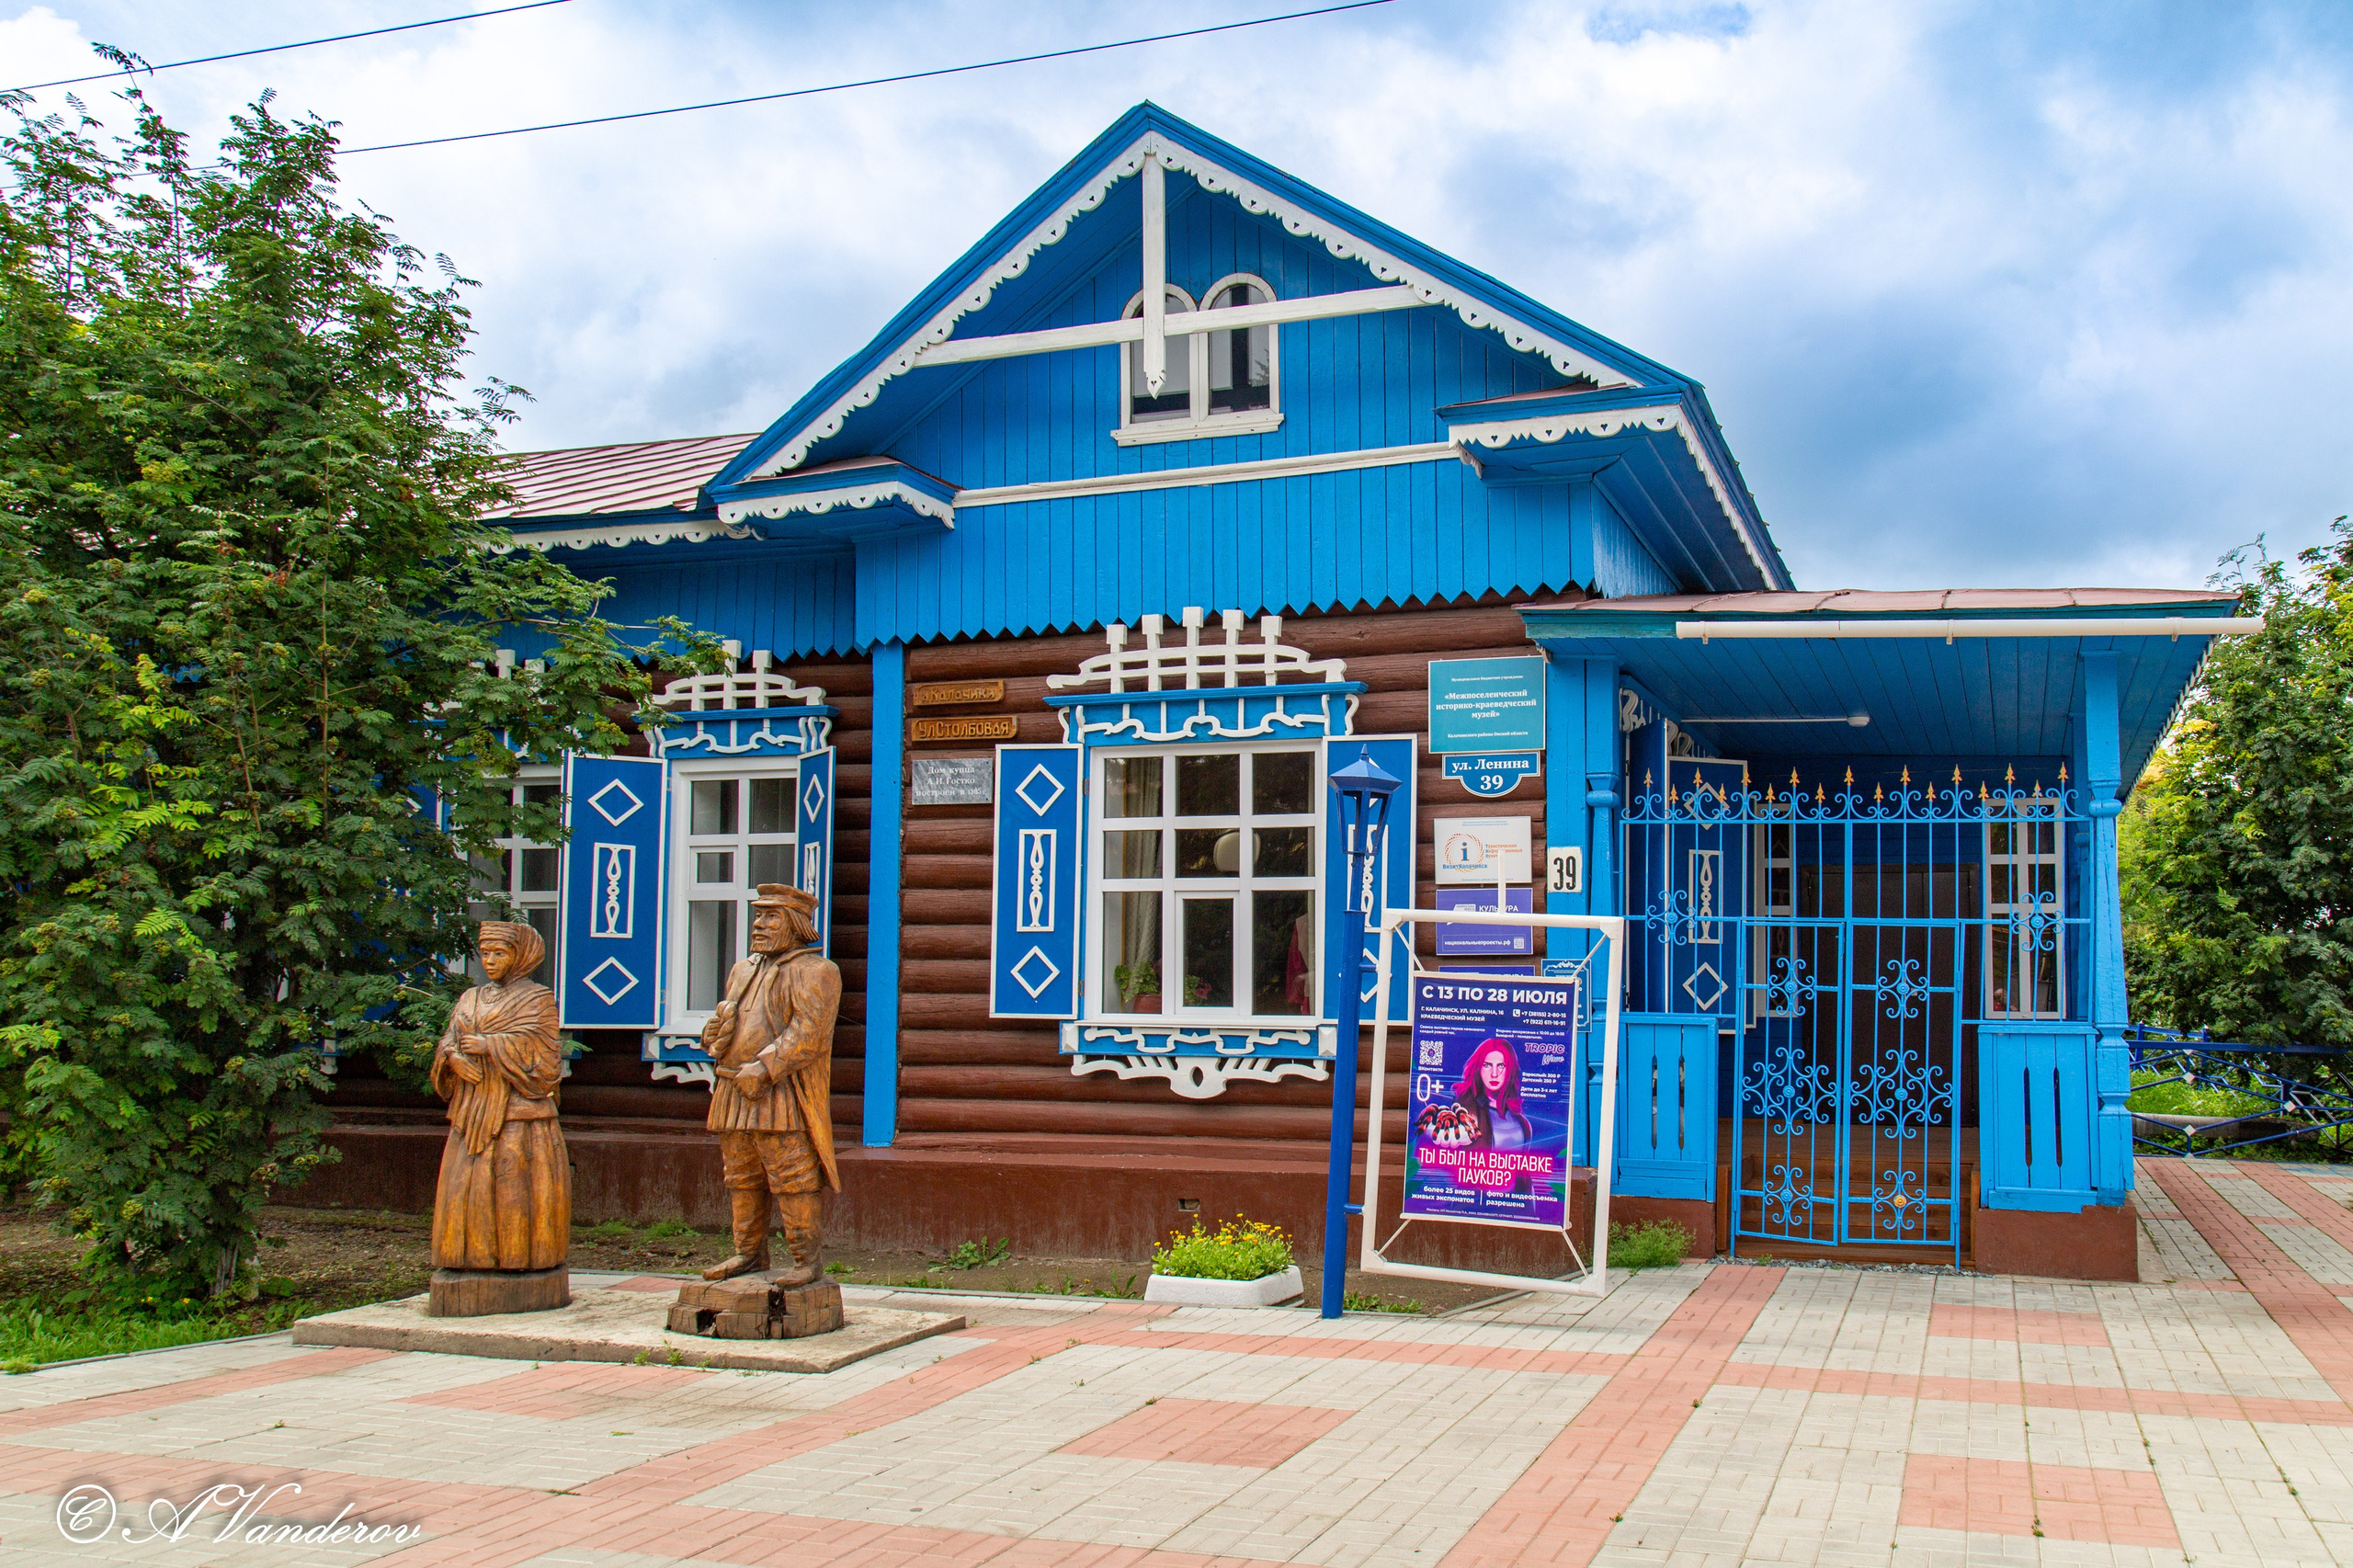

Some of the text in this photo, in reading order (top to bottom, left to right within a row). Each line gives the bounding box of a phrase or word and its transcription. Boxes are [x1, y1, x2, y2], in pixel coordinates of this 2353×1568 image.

[1444, 689, 1528, 699] «Межпоселенческий
[1436, 699, 1537, 711] историко-краеведческий
[1472, 710, 1500, 720] музей»
[949, 767, 975, 775] купца
[1451, 758, 1529, 773] ул. Ленина
[1480, 775, 1504, 790] 39
[915, 790, 956, 798] построен
[1553, 856, 1576, 891] 39
[1479, 904, 1519, 913] КУЛЬУРА
[1422, 985, 1567, 1005] С 13 ПО 28 ИЮЛЯ
[1524, 1041, 1565, 1054] TROPIC
[1416, 1074, 1444, 1102] 0+
[1419, 1147, 1552, 1173] ТЫ БЫЛ НА ВЫСТАВКЕ
[1458, 1167, 1512, 1187] ПАУКОВ?
[1436, 1195, 1475, 1203] экспонатов
[1485, 1199, 1525, 1208] разрешена
[1511, 1193, 1558, 1202] видеосъемка
